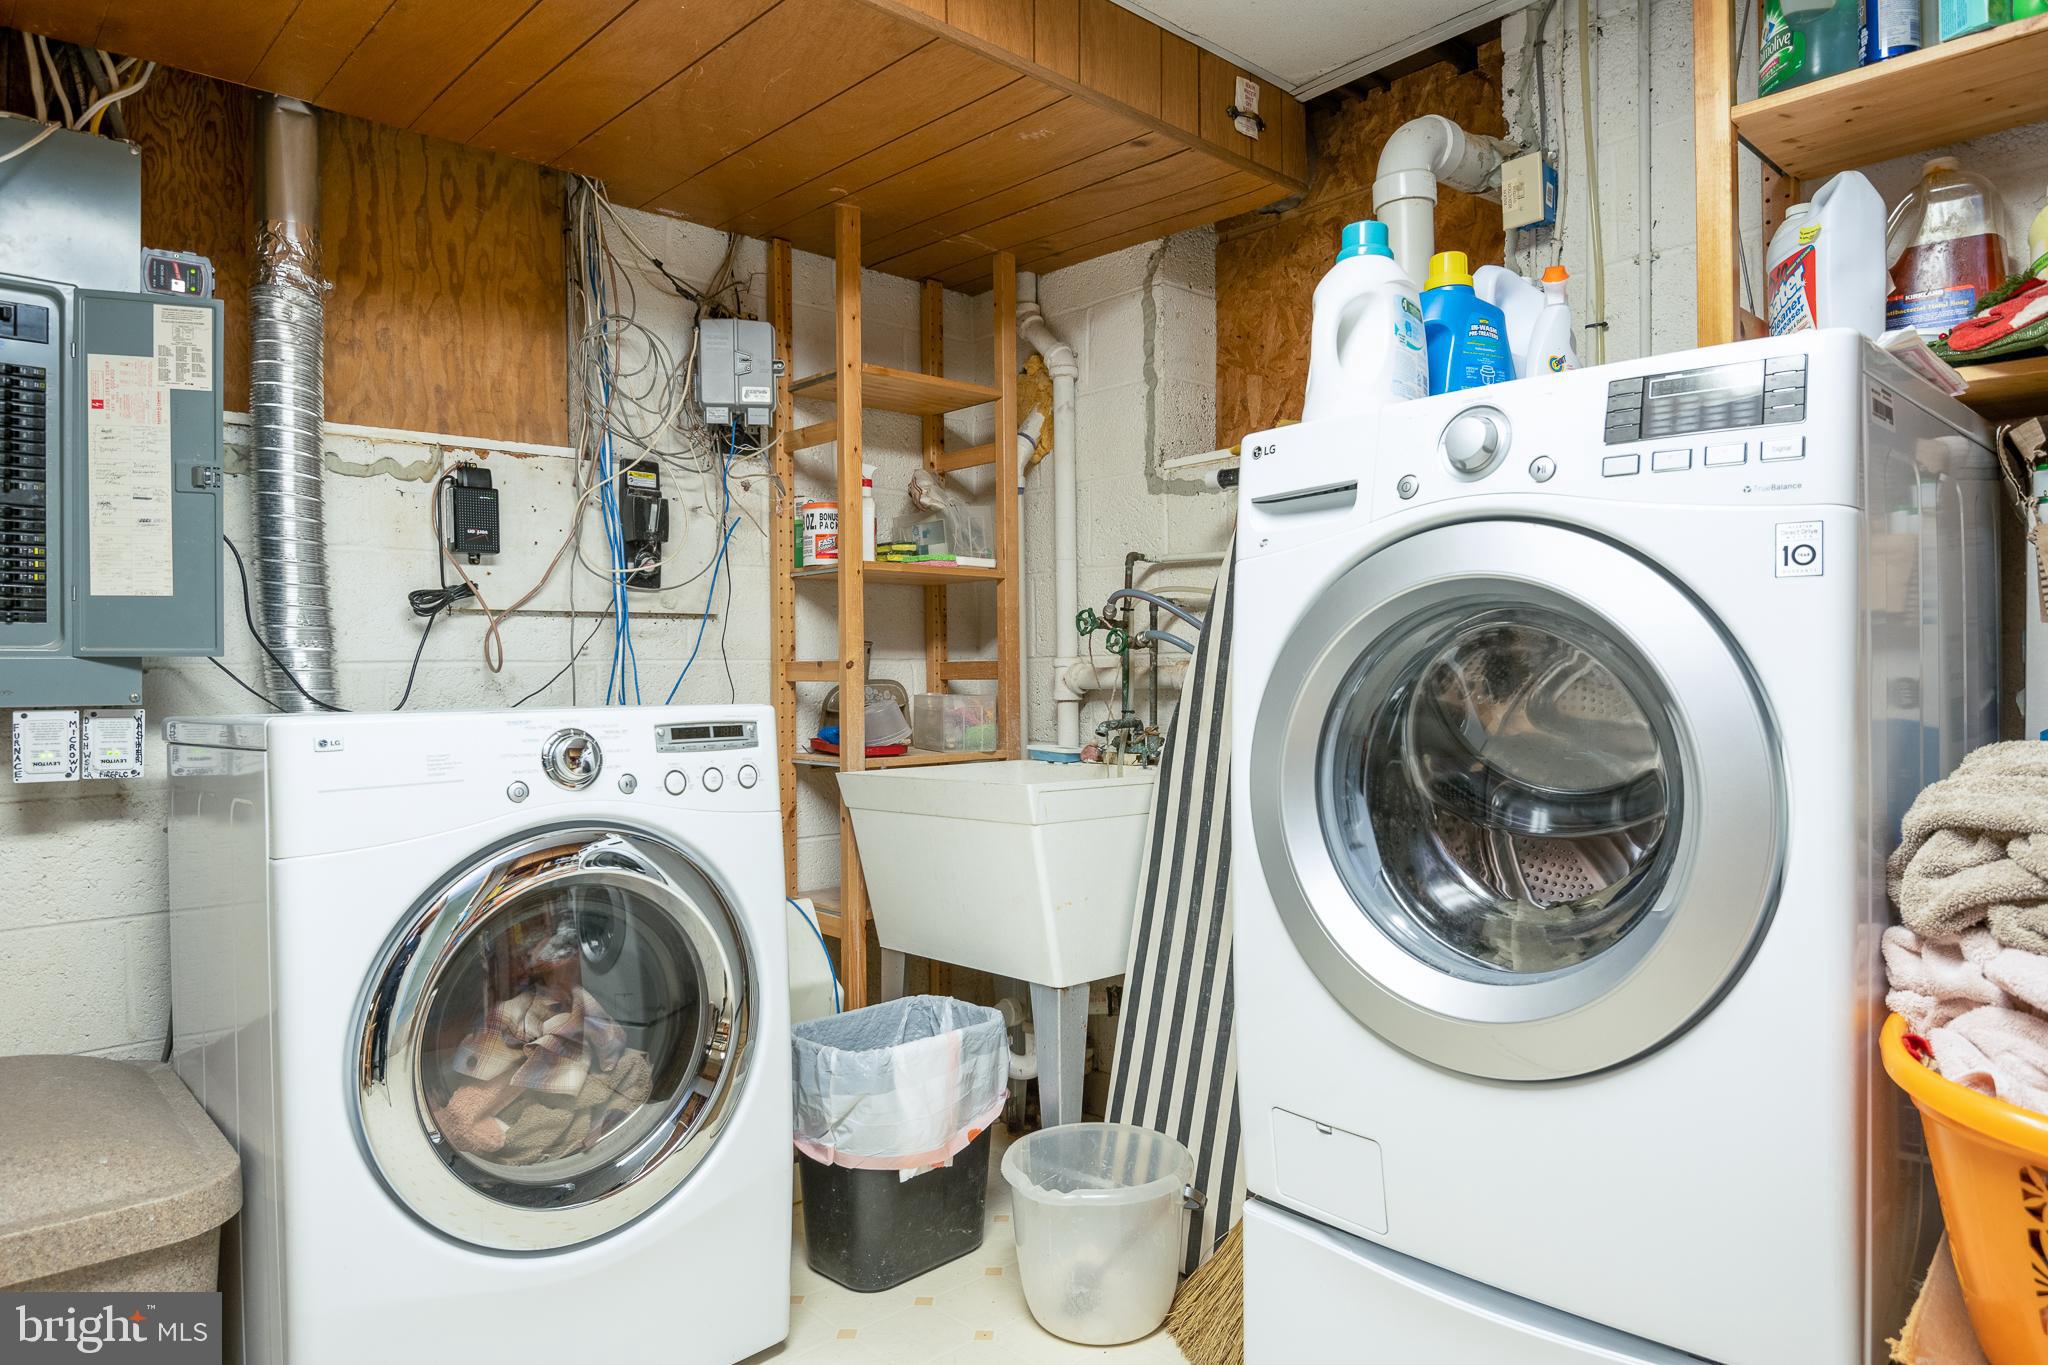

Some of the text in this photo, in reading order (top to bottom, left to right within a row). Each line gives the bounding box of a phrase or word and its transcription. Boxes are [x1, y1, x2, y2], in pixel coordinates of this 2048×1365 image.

[1904, 289, 1944, 300] KIRKLAND
[1782, 544, 1817, 566] 10
[330, 739, 341, 747] LG
